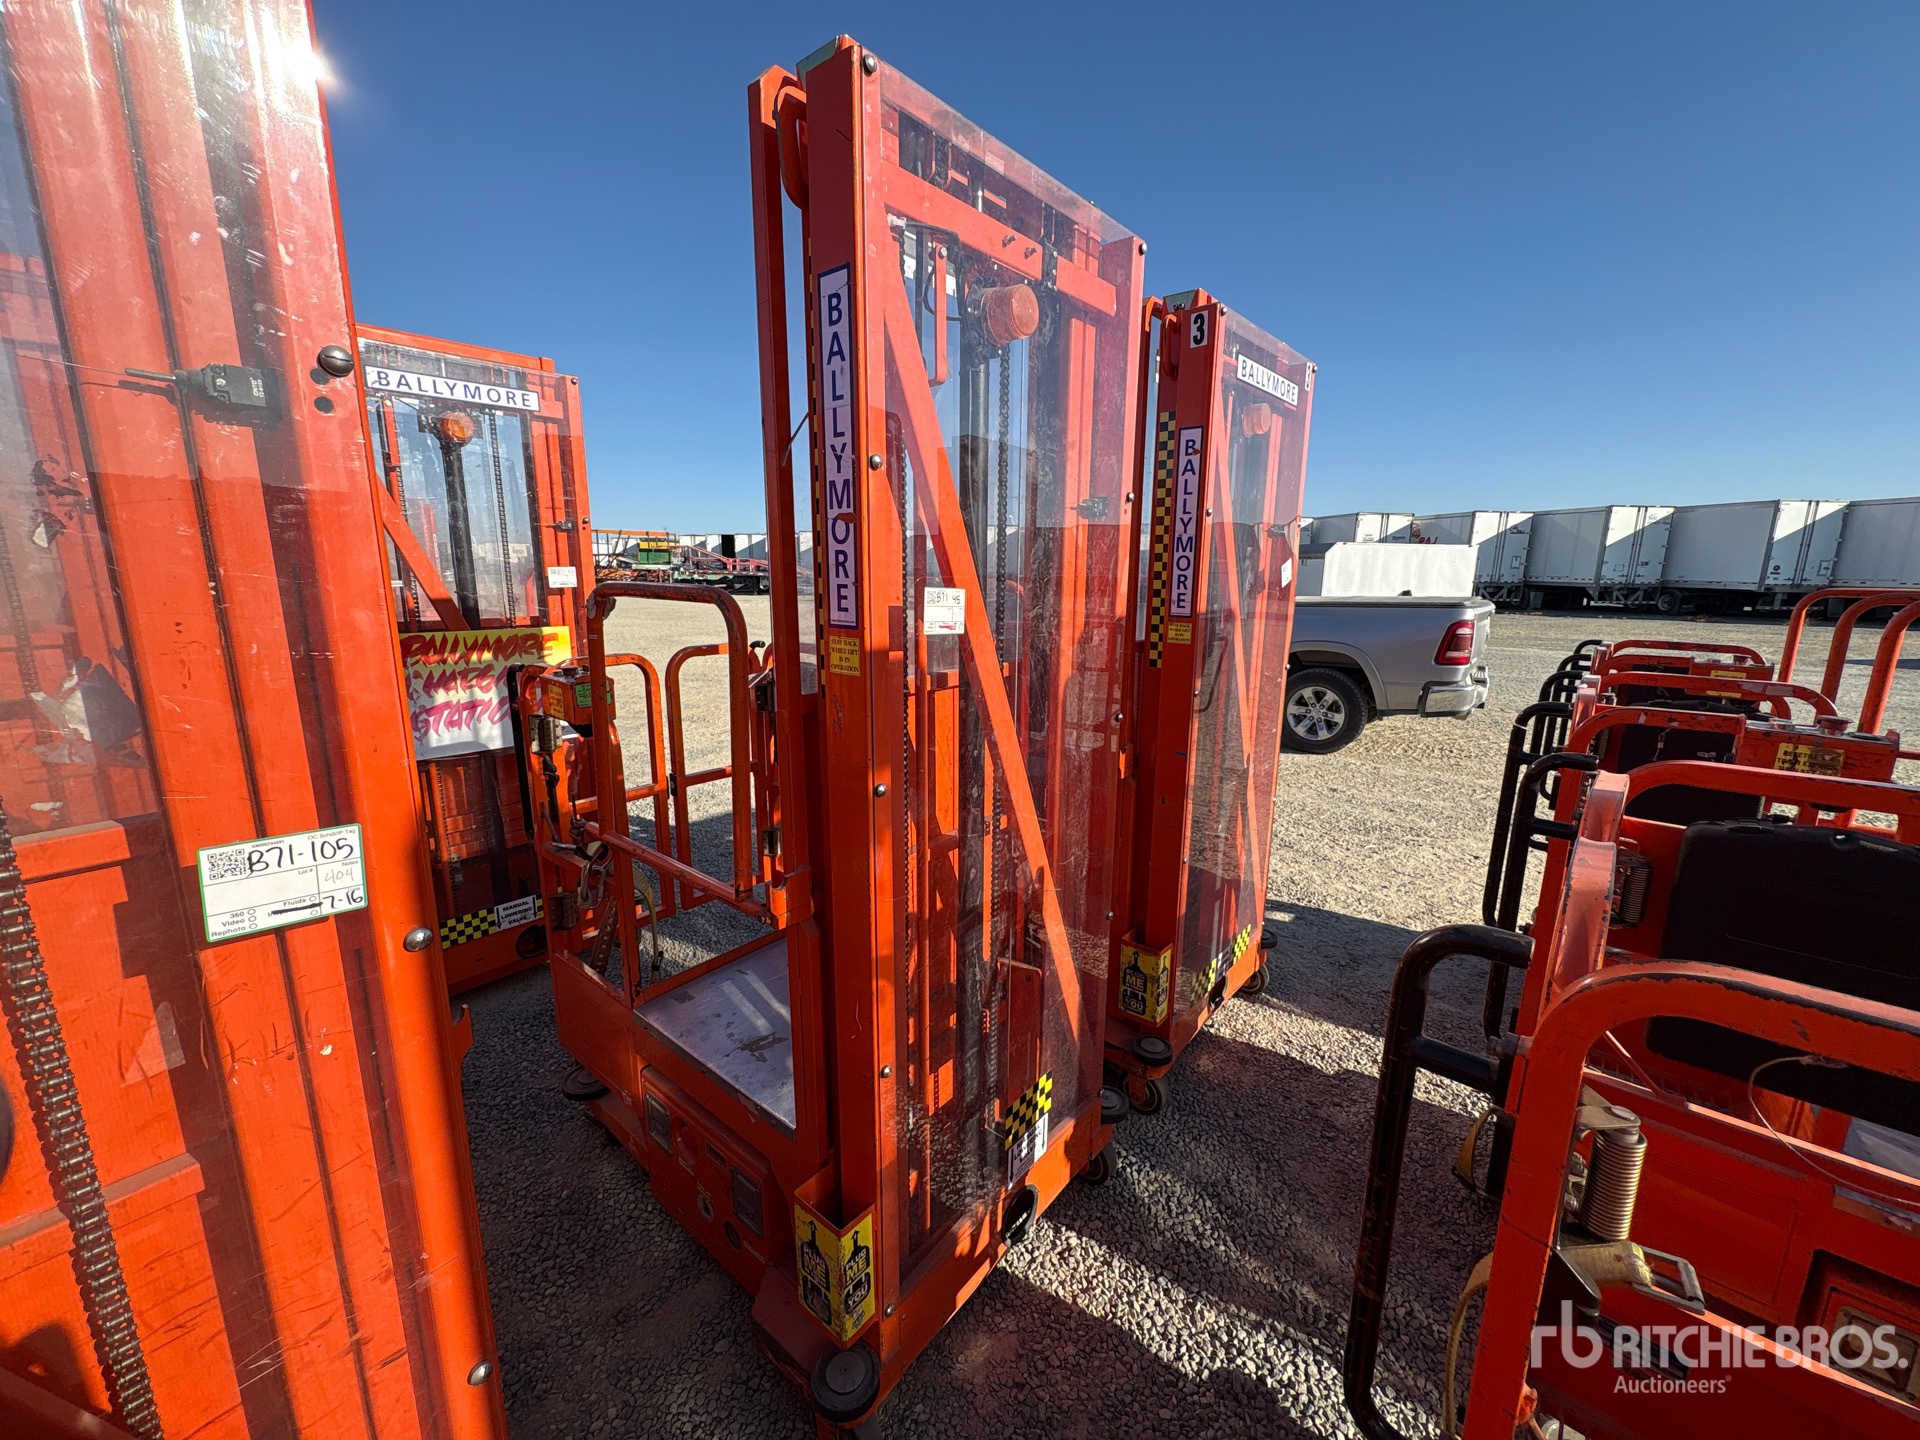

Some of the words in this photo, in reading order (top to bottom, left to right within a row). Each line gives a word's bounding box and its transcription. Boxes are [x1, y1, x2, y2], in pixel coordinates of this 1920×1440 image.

[1192, 312, 1205, 345] 3
[376, 371, 532, 408] BALLYMORE
[1241, 359, 1296, 403] BALLYMORE
[826, 292, 851, 613] BALLYMORE
[1175, 438, 1197, 609] BALLYMORE
[830, 664, 859, 672] OPERATION
[345, 828, 356, 836] Tag
[247, 838, 354, 874] B71-105
[283, 898, 306, 907] Fluids
[500, 906, 533, 920] LOWERING
[502, 900, 530, 912] MANUAL
[221, 918, 246, 928] Video
[230, 911, 245, 919] 360
[507, 915, 527, 925] VALVE
[211, 925, 247, 938] Rephoto
[1125, 974, 1145, 987] ME
[803, 1245, 826, 1268] PLUG
[804, 1253, 826, 1279] ME
[845, 1247, 867, 1272] PLUG
[845, 1256, 868, 1282] ME
[847, 1283, 868, 1306] YOU
